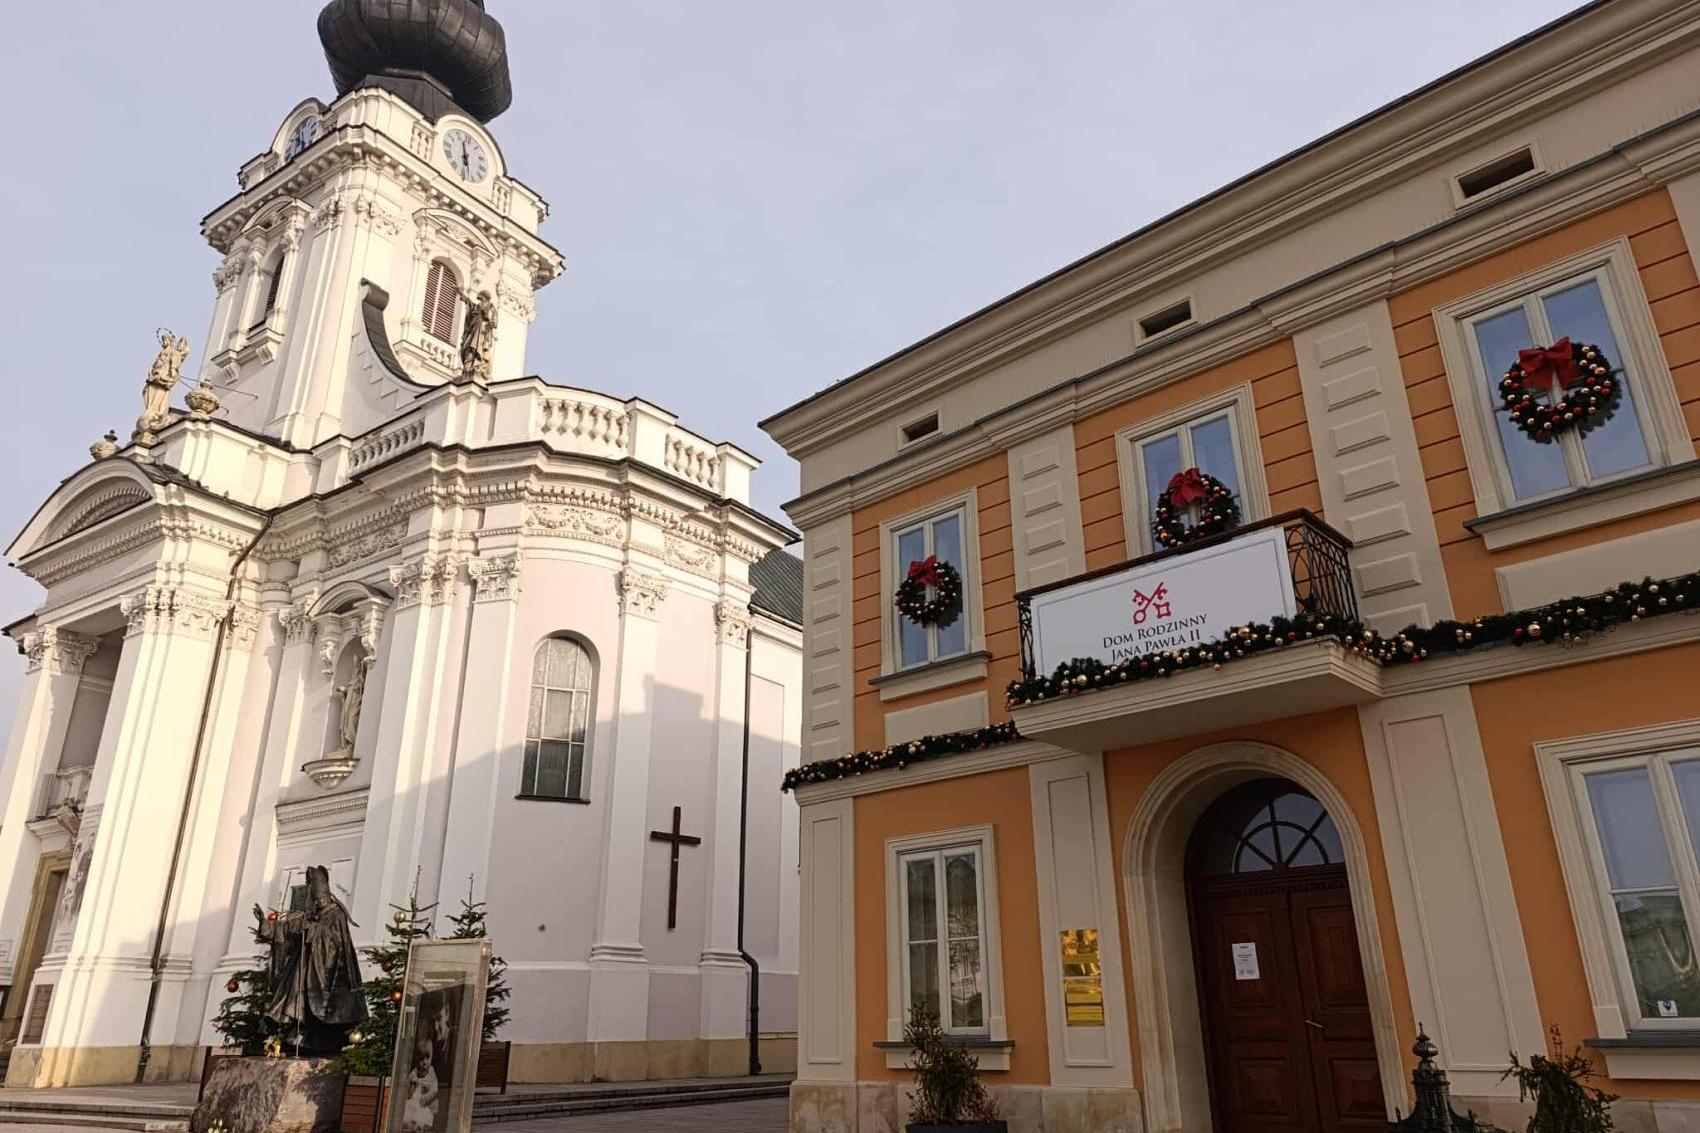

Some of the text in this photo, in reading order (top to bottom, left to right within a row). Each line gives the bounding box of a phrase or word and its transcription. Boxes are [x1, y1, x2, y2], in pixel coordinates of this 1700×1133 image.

[1103, 614, 1207, 648] DOM RODZINNY
[1112, 645, 1141, 662] JANA
[1190, 629, 1200, 642] II
